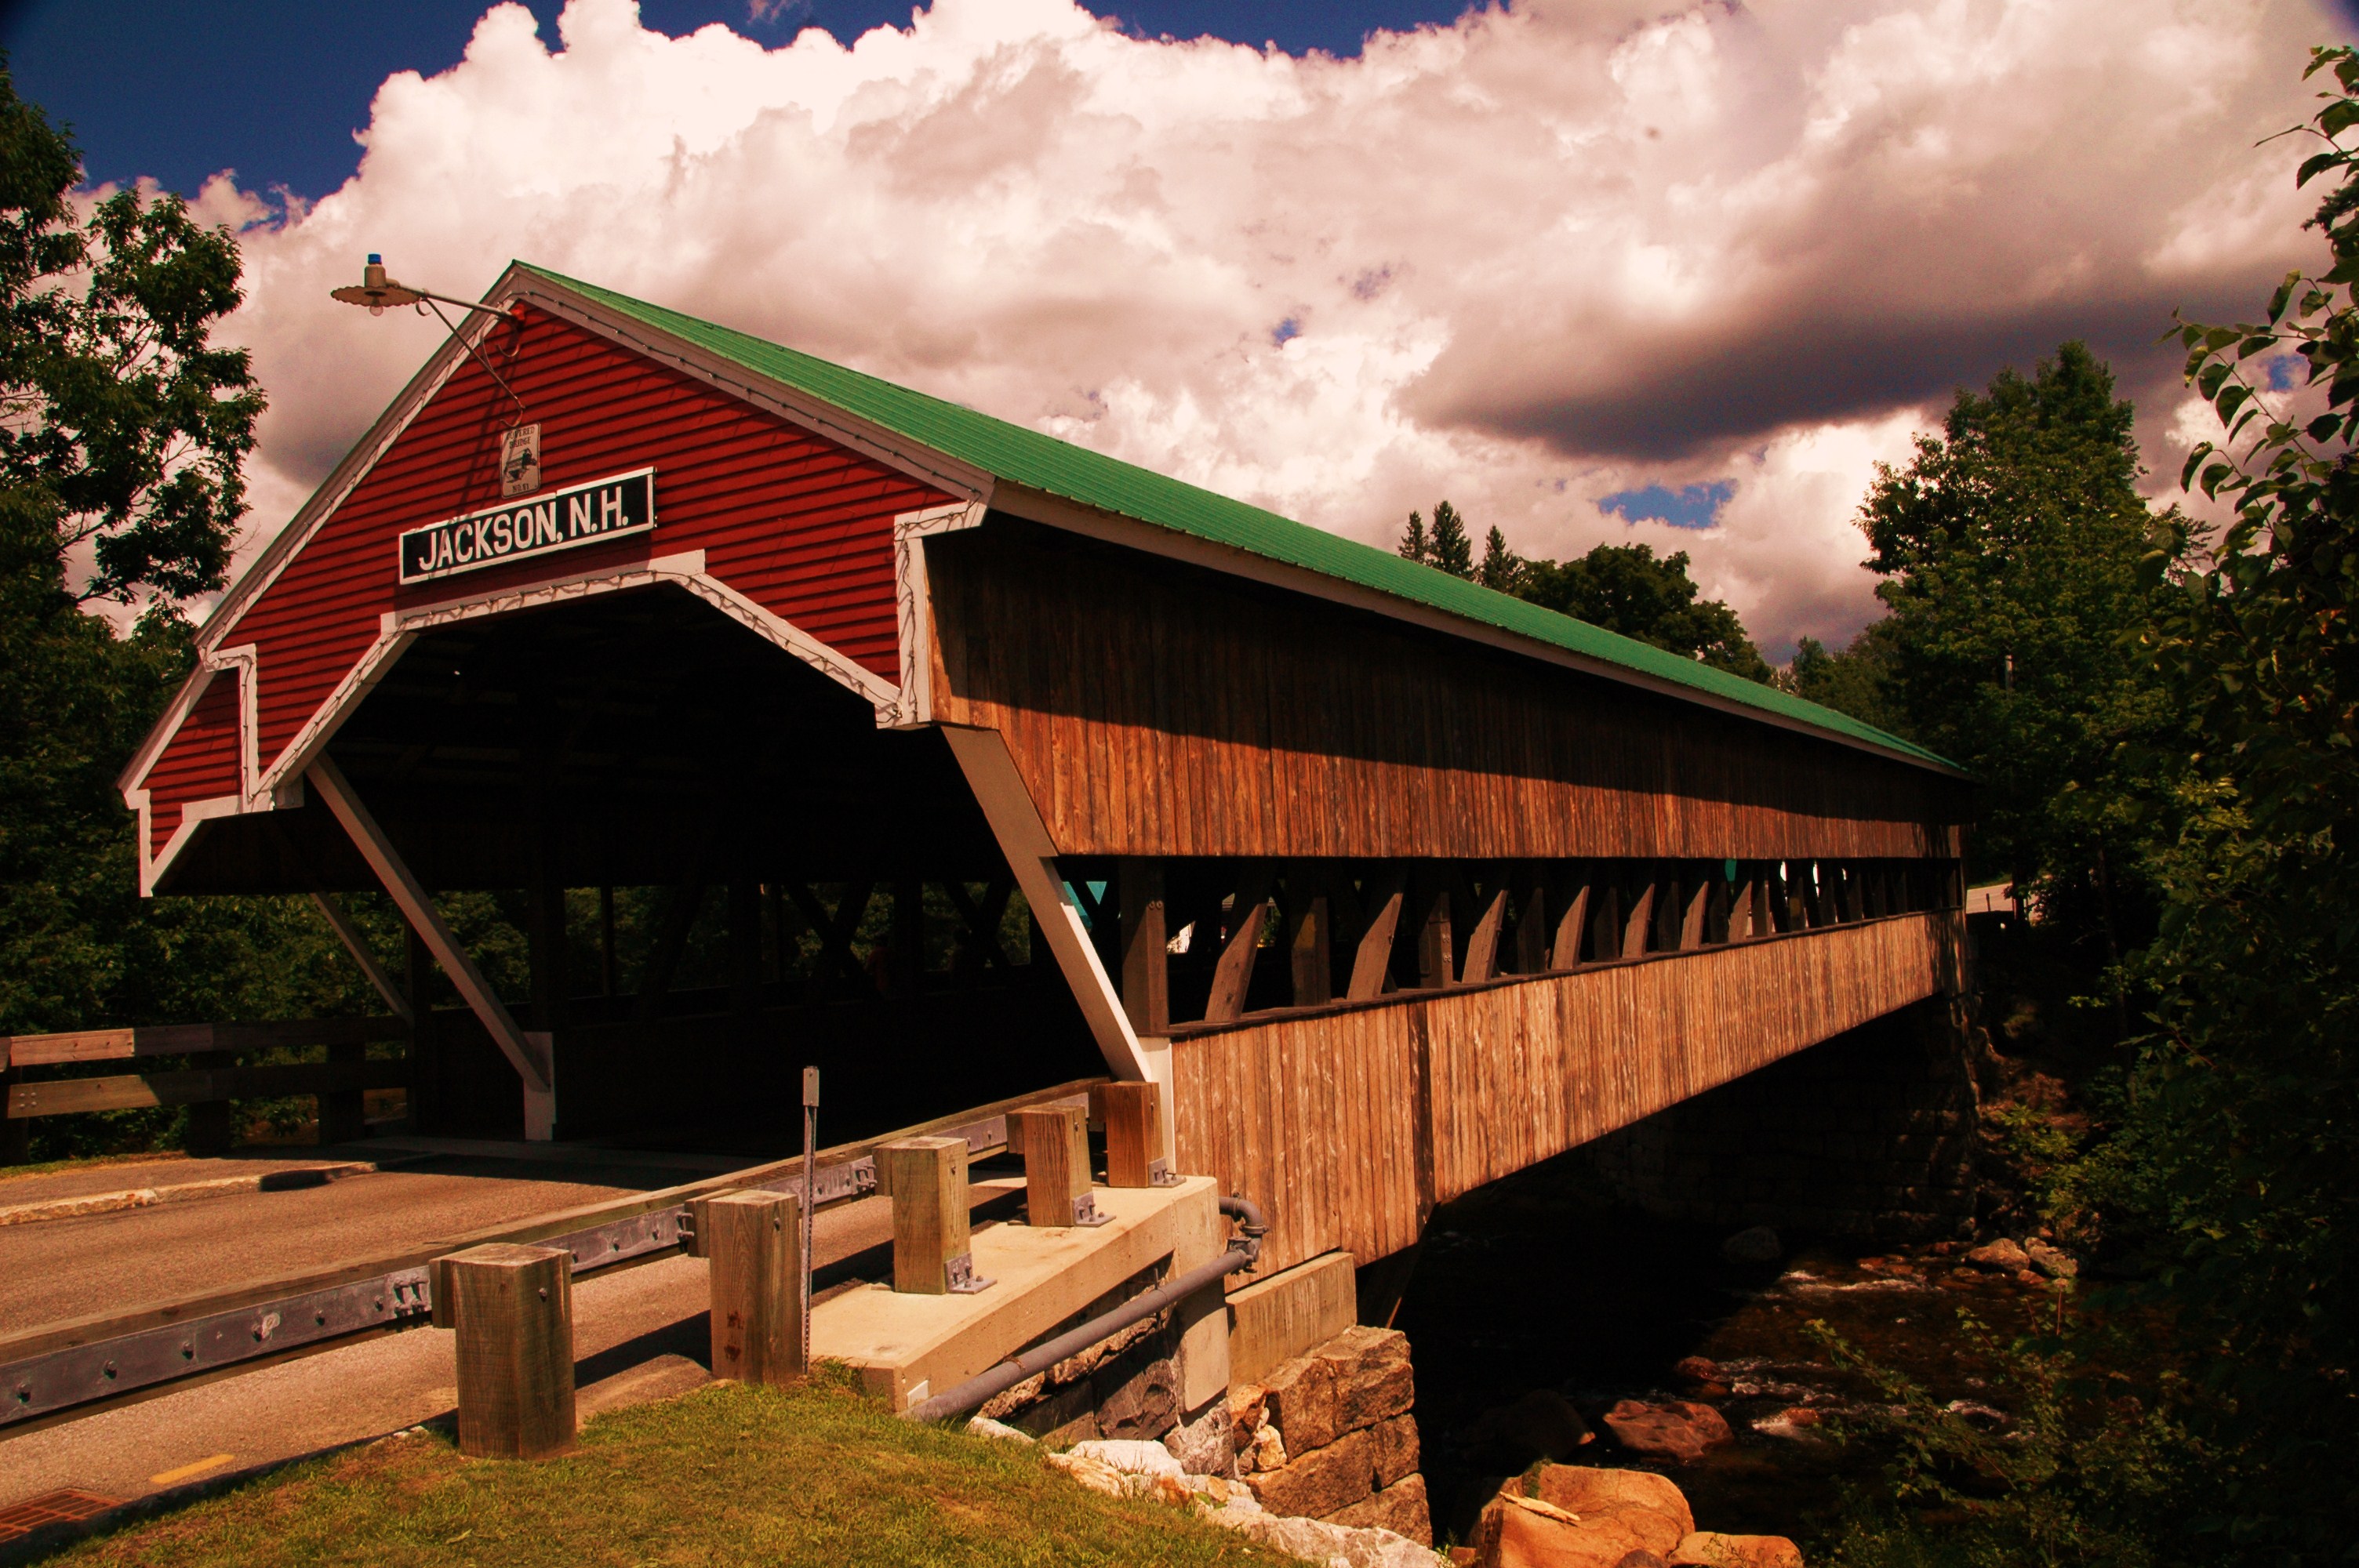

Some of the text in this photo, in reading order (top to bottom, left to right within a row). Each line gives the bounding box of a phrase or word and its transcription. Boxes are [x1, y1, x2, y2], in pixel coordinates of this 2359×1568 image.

[509, 437, 531, 449] BRIDGE
[419, 485, 629, 571] JACKSON, N.H.
